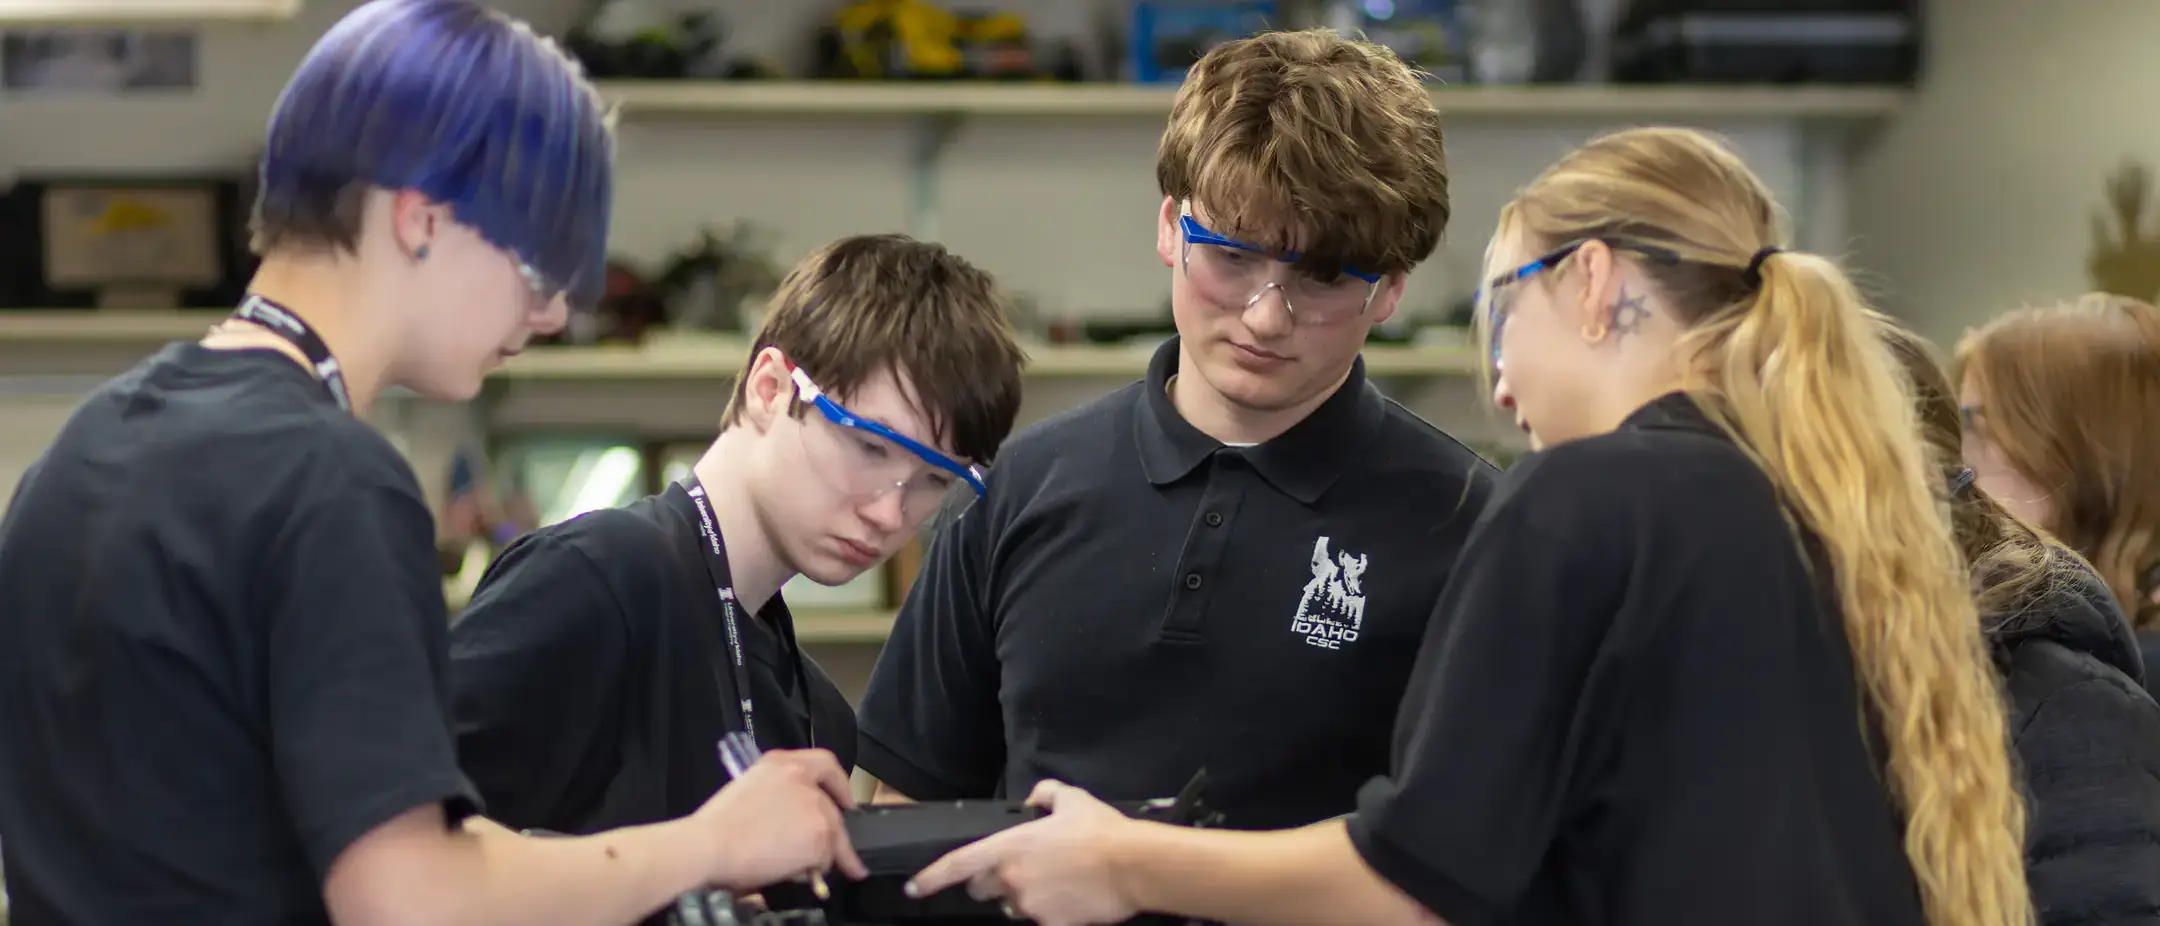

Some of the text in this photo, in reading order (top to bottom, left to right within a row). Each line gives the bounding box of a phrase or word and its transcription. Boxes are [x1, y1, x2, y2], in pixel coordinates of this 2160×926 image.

[709, 532, 720, 555] Idaho
[1291, 617, 1359, 642] IDAHO
[1306, 635, 1341, 650] CSC
